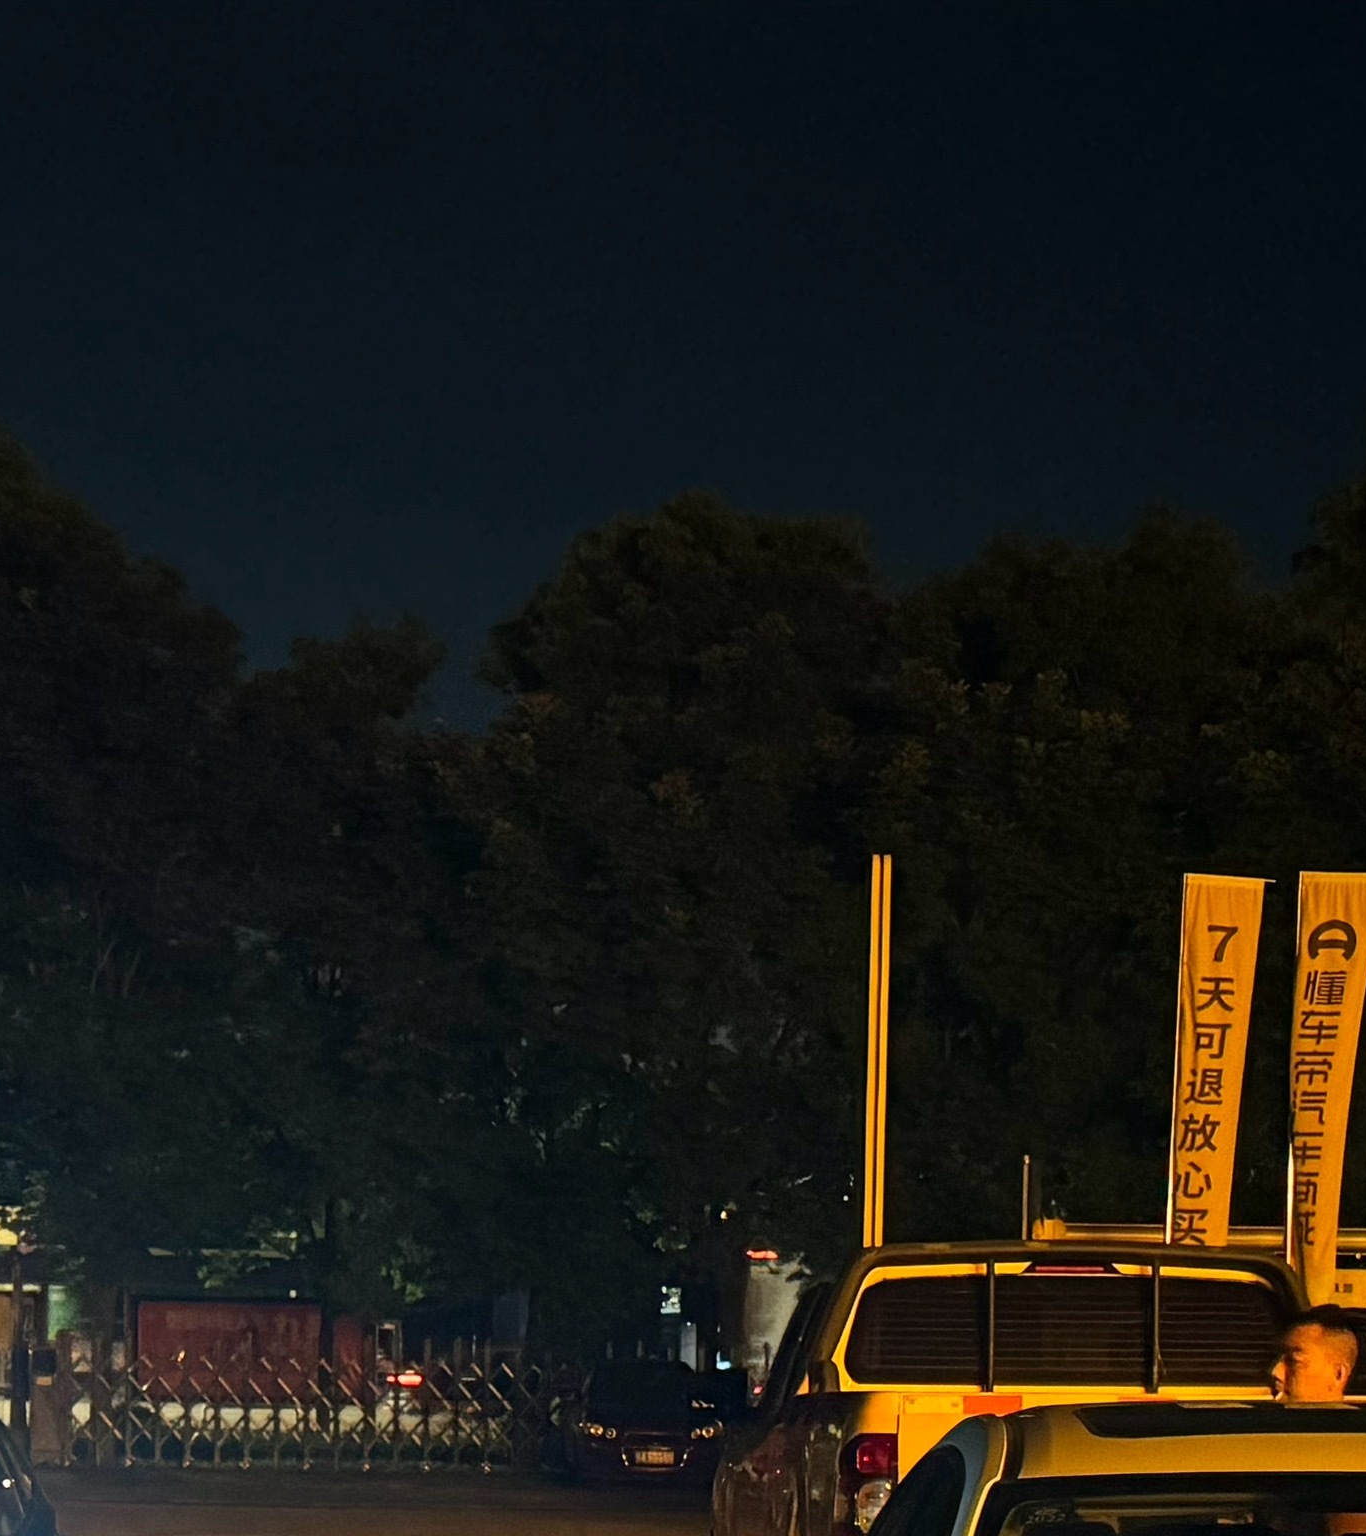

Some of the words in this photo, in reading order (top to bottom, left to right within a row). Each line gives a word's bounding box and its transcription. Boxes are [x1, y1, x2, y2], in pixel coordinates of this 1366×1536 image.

[1175, 924, 1240, 1247] 7天可退放心买
